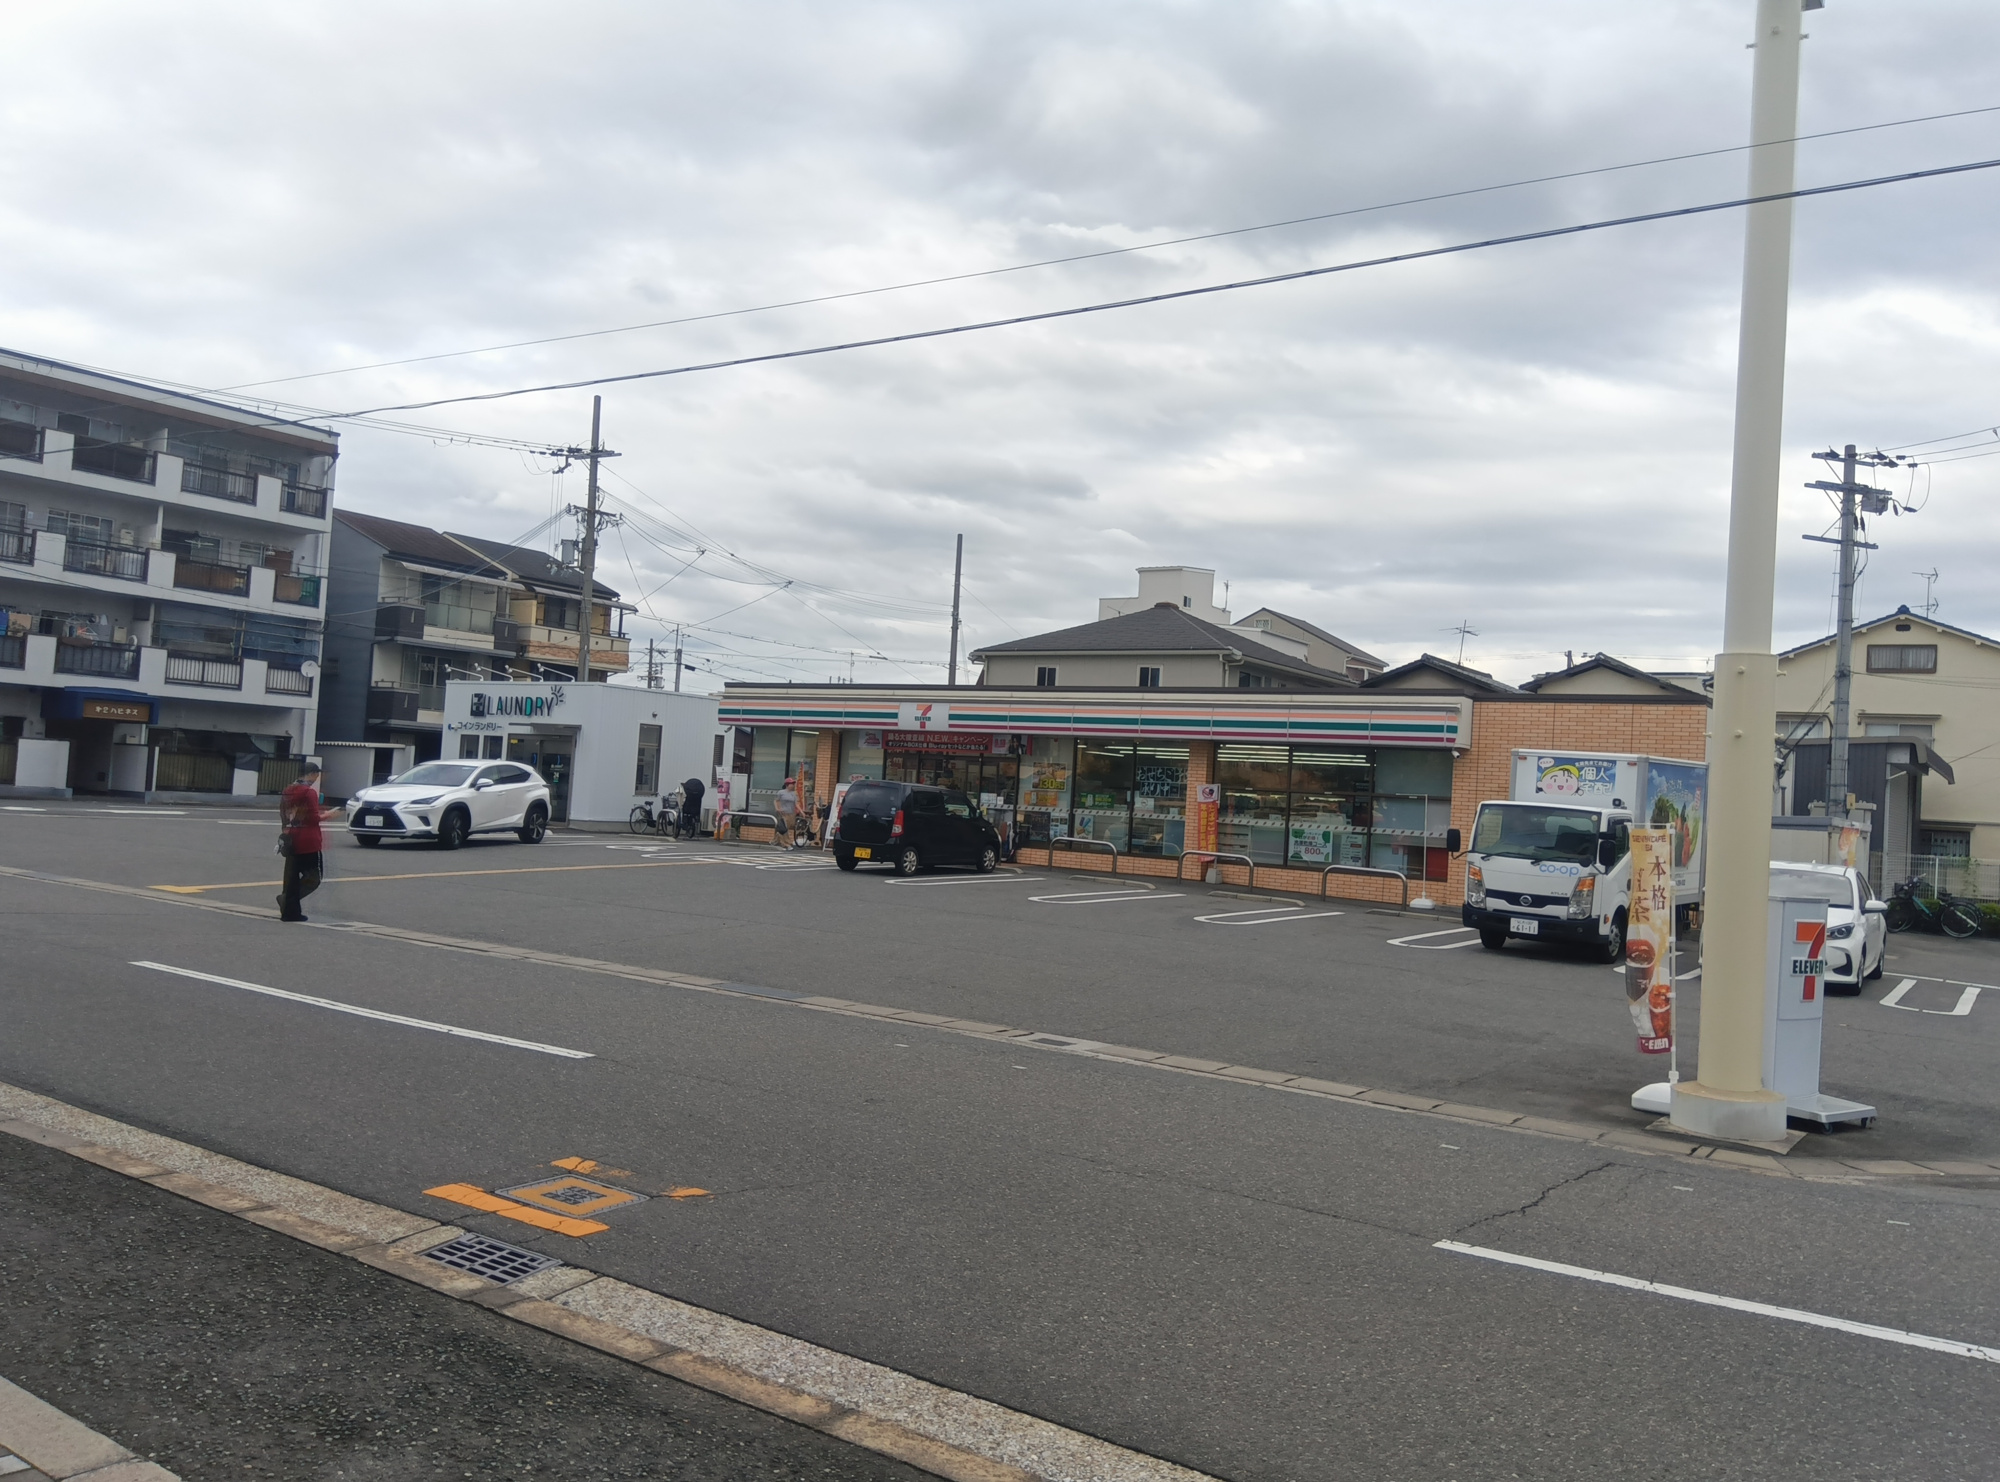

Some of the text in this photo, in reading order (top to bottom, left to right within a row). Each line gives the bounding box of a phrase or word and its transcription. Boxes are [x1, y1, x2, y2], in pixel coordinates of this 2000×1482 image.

[487, 696, 554, 717] LAUNDRY
[1580, 767, 1609, 781] 個人
[1539, 864, 1579, 877] co-op
[1648, 855, 1667, 911] 本格
[1796, 921, 1826, 1000] 7
